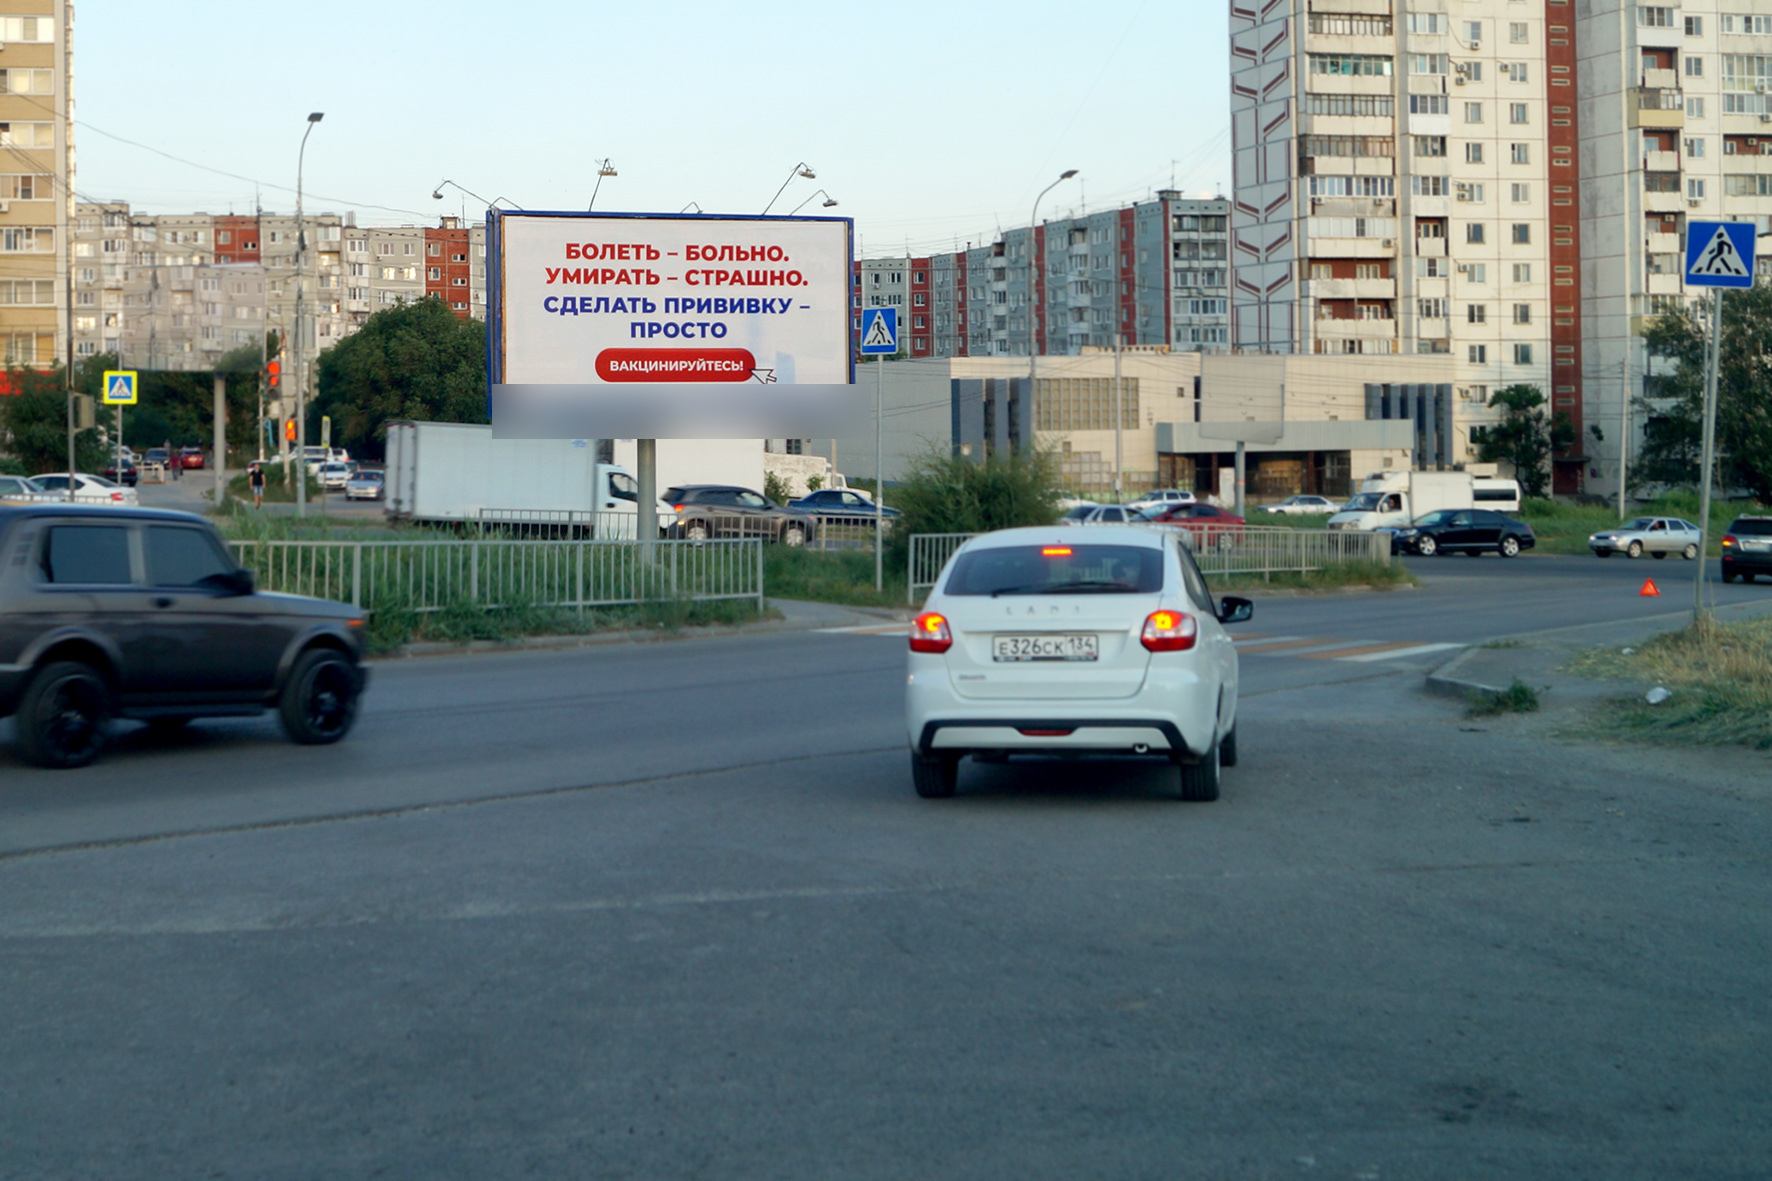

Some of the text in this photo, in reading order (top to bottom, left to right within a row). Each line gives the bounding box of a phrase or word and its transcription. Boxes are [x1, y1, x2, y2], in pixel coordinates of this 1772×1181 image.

[566, 243, 660, 260] БОЛЕТЬ
[685, 245, 789, 262] БОЛЬНО.
[545, 268, 660, 285] УМИРАТЬ
[685, 269, 808, 287] СТРАШНО.
[543, 296, 656, 316] СДЕЛАТЬ
[664, 297, 792, 314] ПРИВИВКУ
[630, 322, 727, 339] ПРОСТО
[609, 358, 744, 375] ВАКЦИНИРУЙТЕСЬ!
